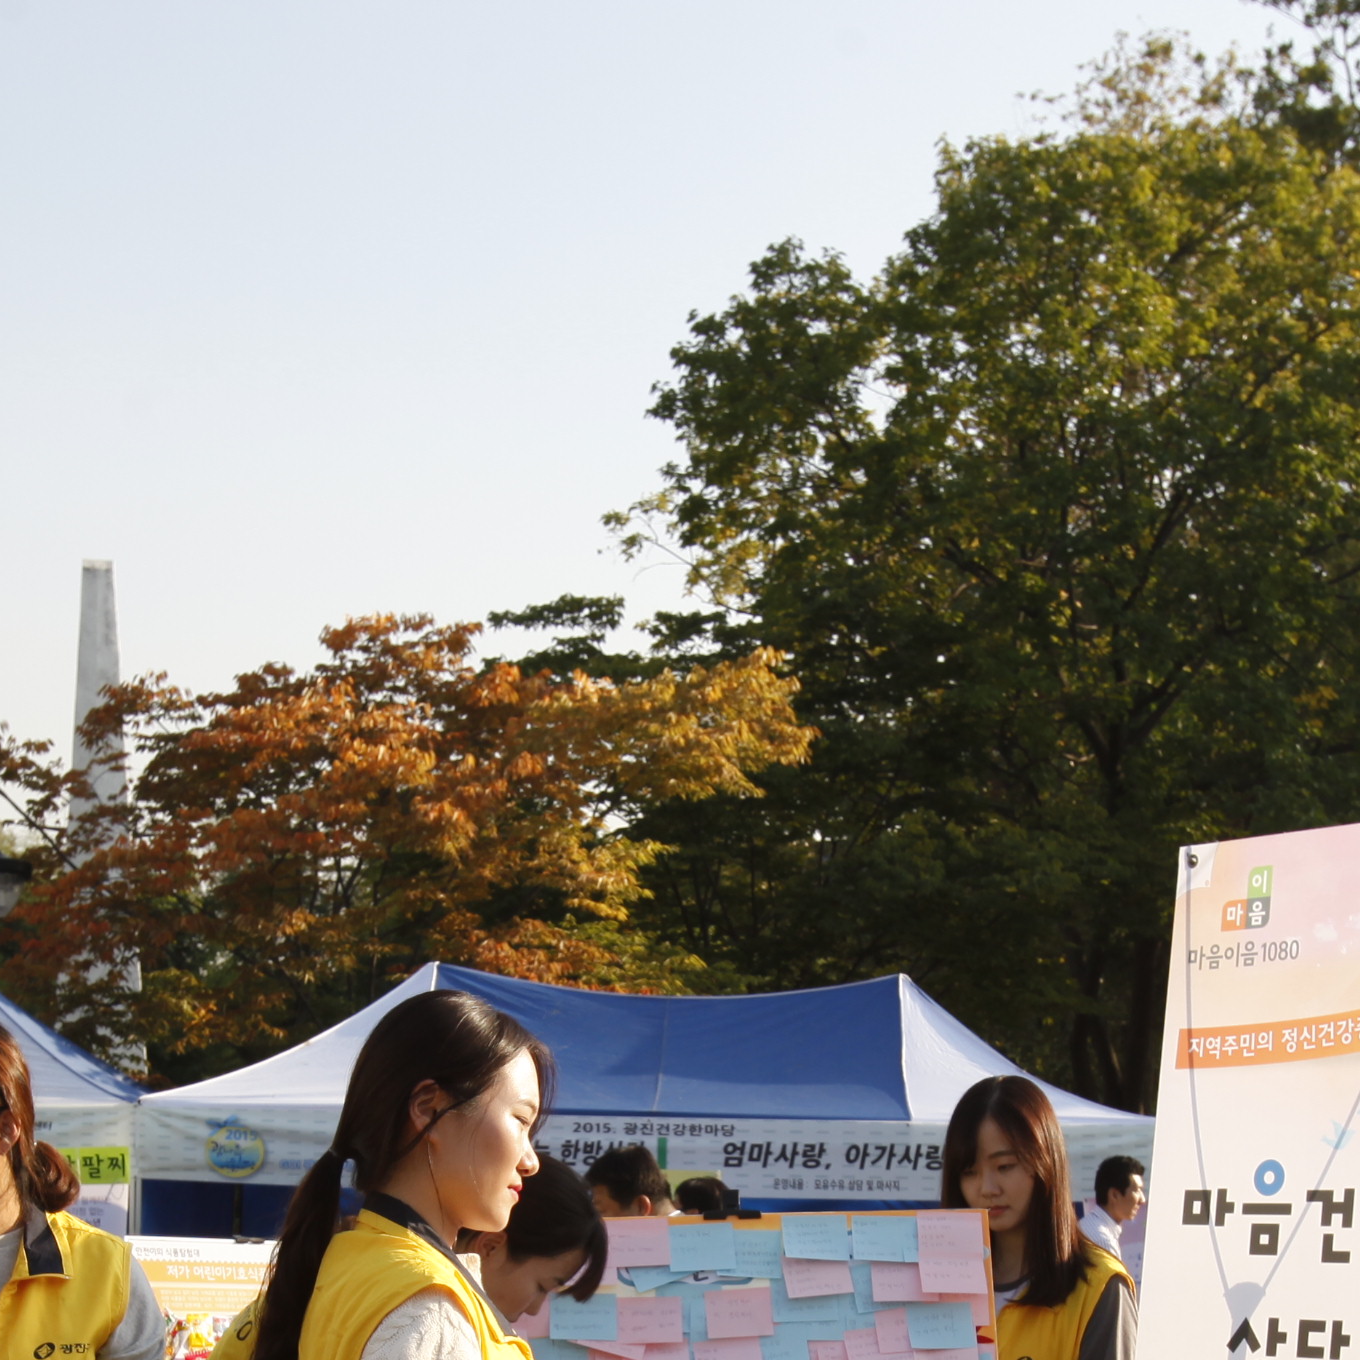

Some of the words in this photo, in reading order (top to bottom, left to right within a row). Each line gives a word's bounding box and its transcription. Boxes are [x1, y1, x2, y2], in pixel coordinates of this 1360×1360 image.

[1188, 1029, 1274, 1061] 지역주민의
[573, 1122, 616, 1134] 2015.
[623, 1122, 736, 1138] 광진건강한마당
[82, 1153, 126, 1179] 팔찌
[723, 1141, 832, 1171] 엄마사랑,
